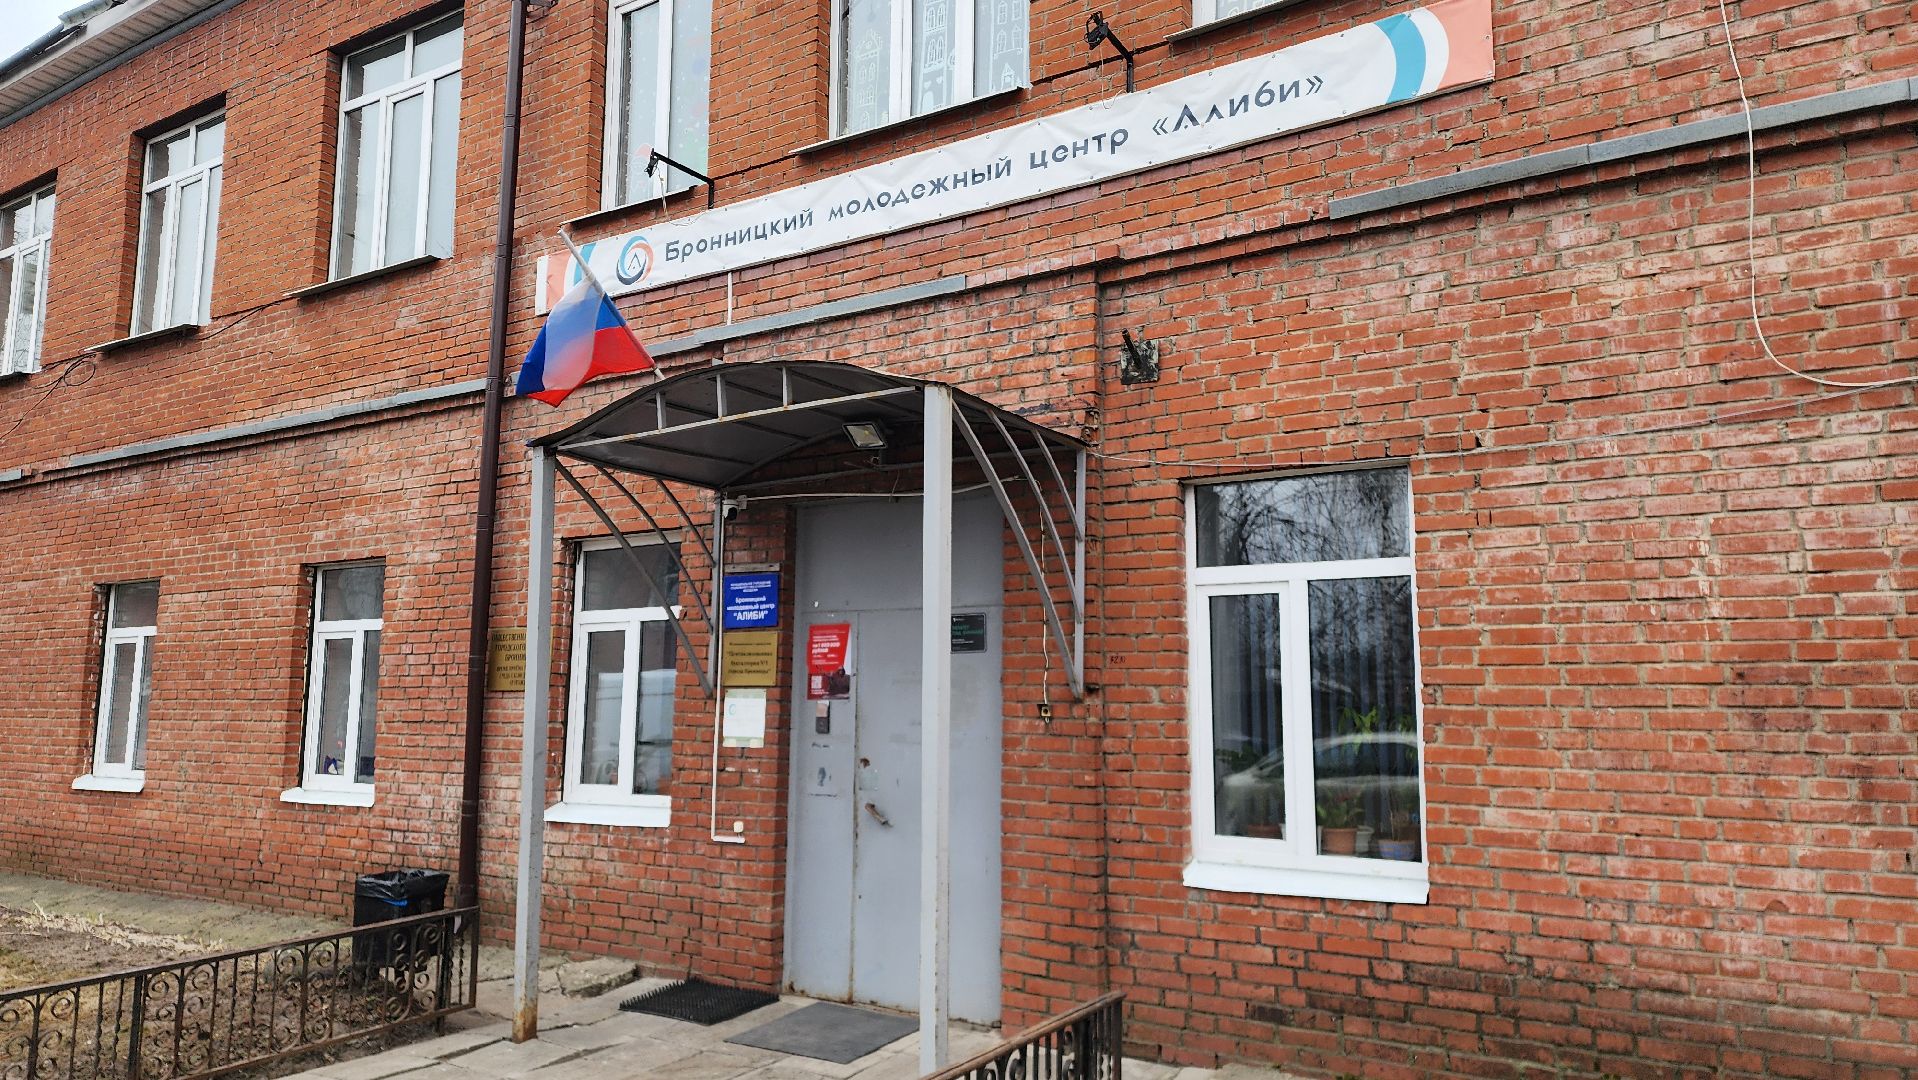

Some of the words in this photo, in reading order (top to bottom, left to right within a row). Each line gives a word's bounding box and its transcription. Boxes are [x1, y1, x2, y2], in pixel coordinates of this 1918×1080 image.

[665, 207, 814, 263] Бронницкий
[828, 155, 1012, 222] молодежный
[1029, 128, 1129, 169] центр
[1152, 75, 1324, 136] «Алиби»
